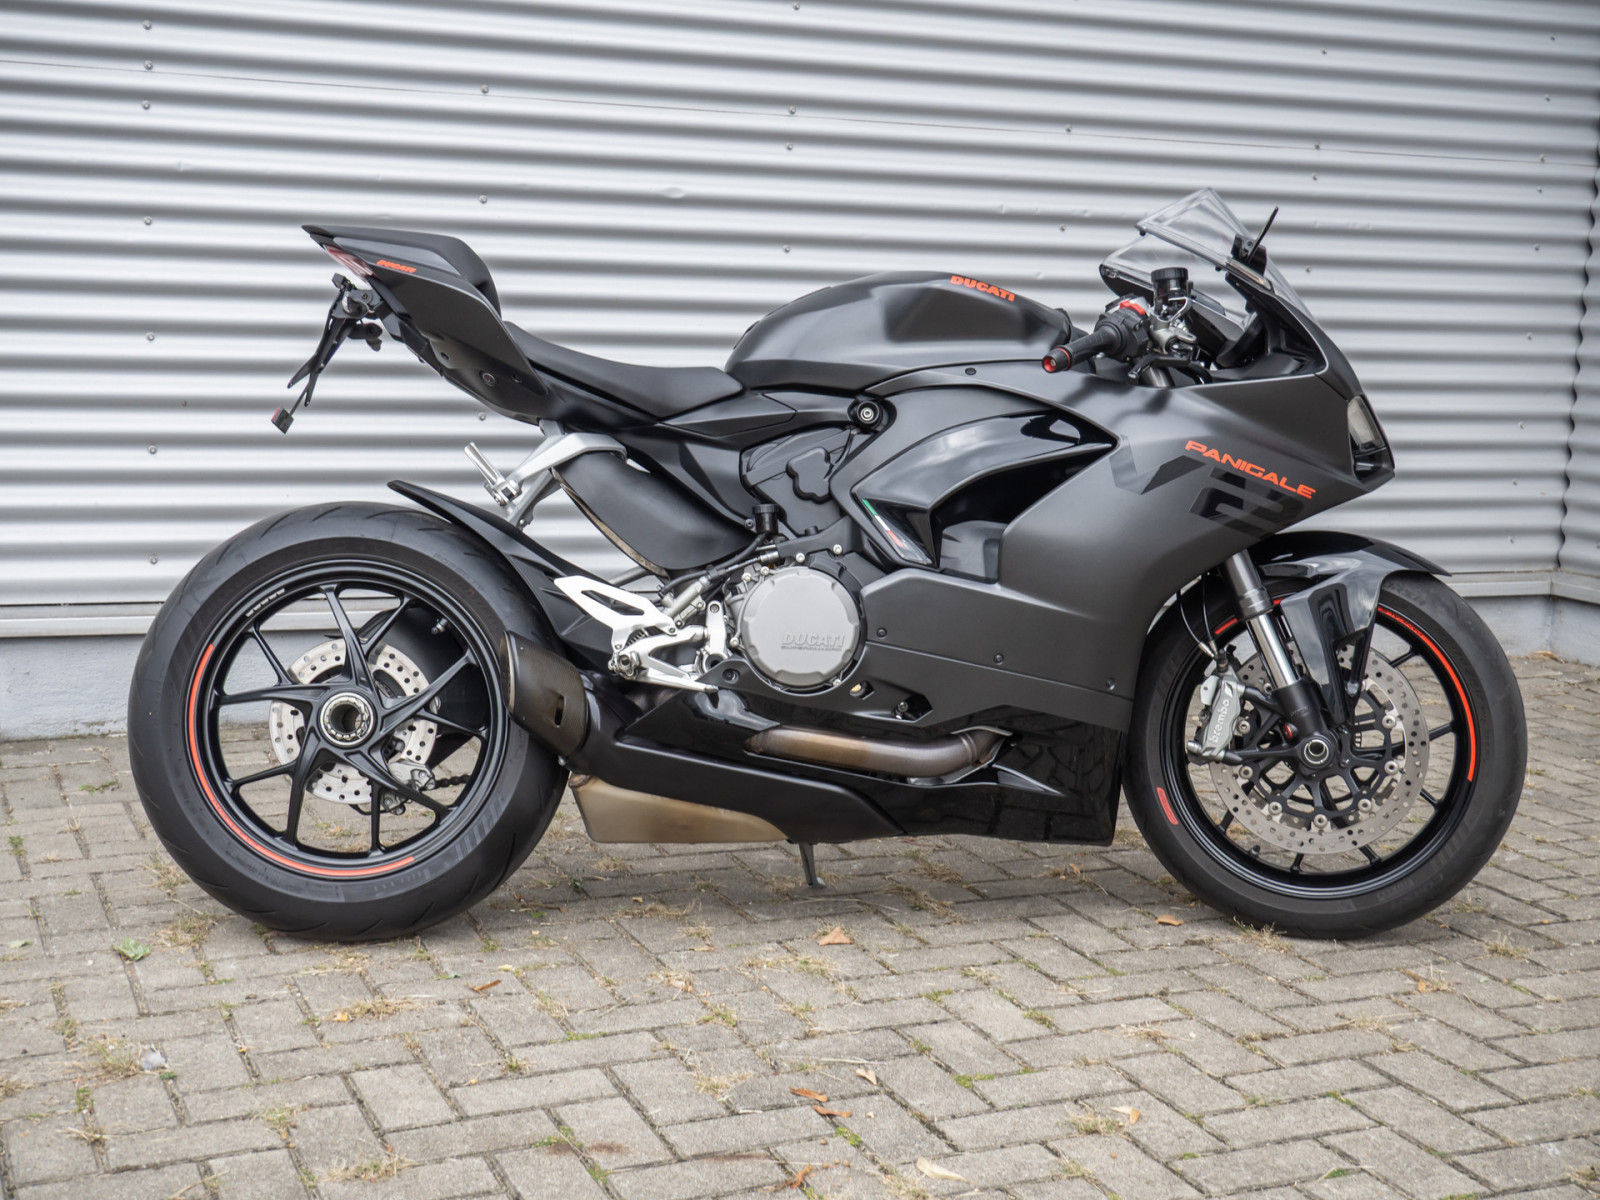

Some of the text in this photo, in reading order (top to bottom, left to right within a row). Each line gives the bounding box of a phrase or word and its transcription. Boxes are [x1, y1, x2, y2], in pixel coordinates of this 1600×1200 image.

[376, 259, 417, 274] DUCATI
[949, 275, 1016, 302] DUCATI
[1185, 440, 1317, 499] PANIGALE
[781, 632, 846, 648] DUCATI
[1209, 699, 1231, 744] brembo
